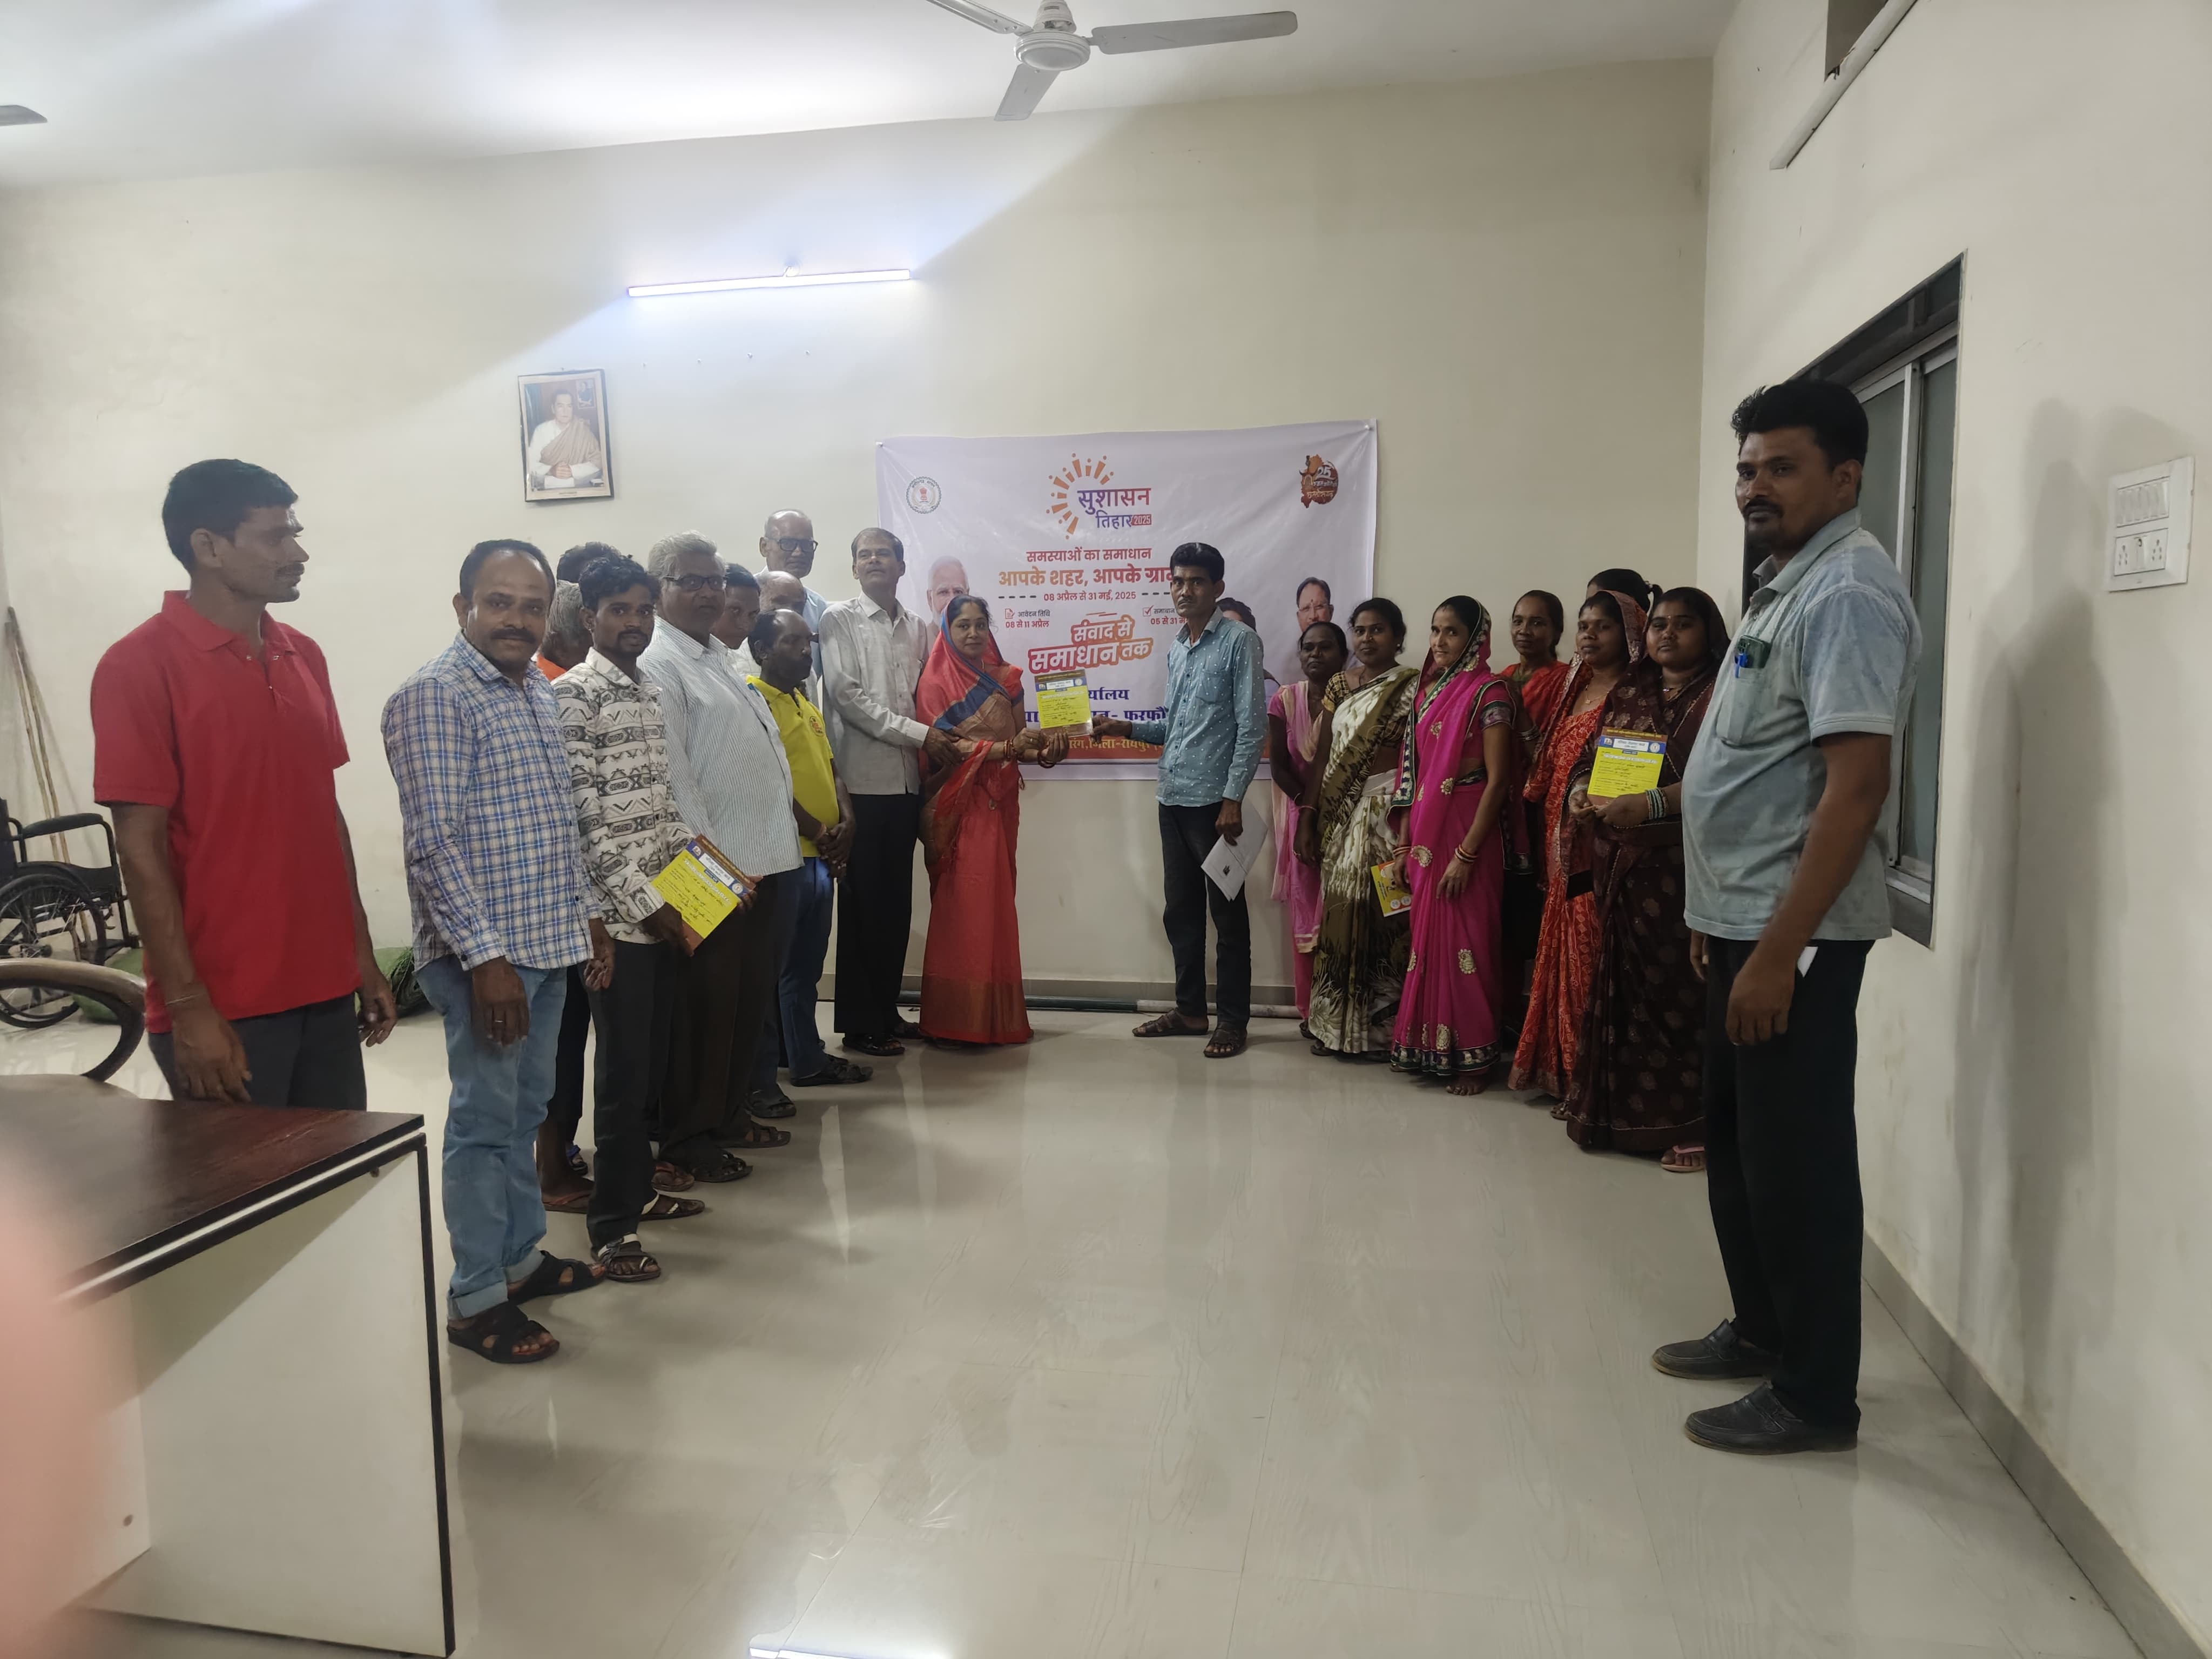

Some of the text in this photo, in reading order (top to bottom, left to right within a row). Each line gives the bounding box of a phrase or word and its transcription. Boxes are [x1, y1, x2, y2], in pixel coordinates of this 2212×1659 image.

[1077, 488, 1151, 515] सुशासन
[1095, 510, 1151, 529] तिहार 2025
[1026, 547, 1152, 562] समस्याओं का समाधान
[999, 566, 1046, 586] आपके
[1050, 569, 1088, 587] शहर,
[1093, 563, 1142, 584] आपके
[1044, 590, 1136, 602] 08 अप्रैल से 31 मई, 2025
[1017, 619, 1023, 628] से
[1031, 618, 1050, 628] अप्रैल
[1162, 616, 1169, 625] से
[1074, 617, 1132, 642] संवाद से
[1031, 640, 1151, 671] समाधान तक
[1088, 687, 1130, 700] र्यालय
